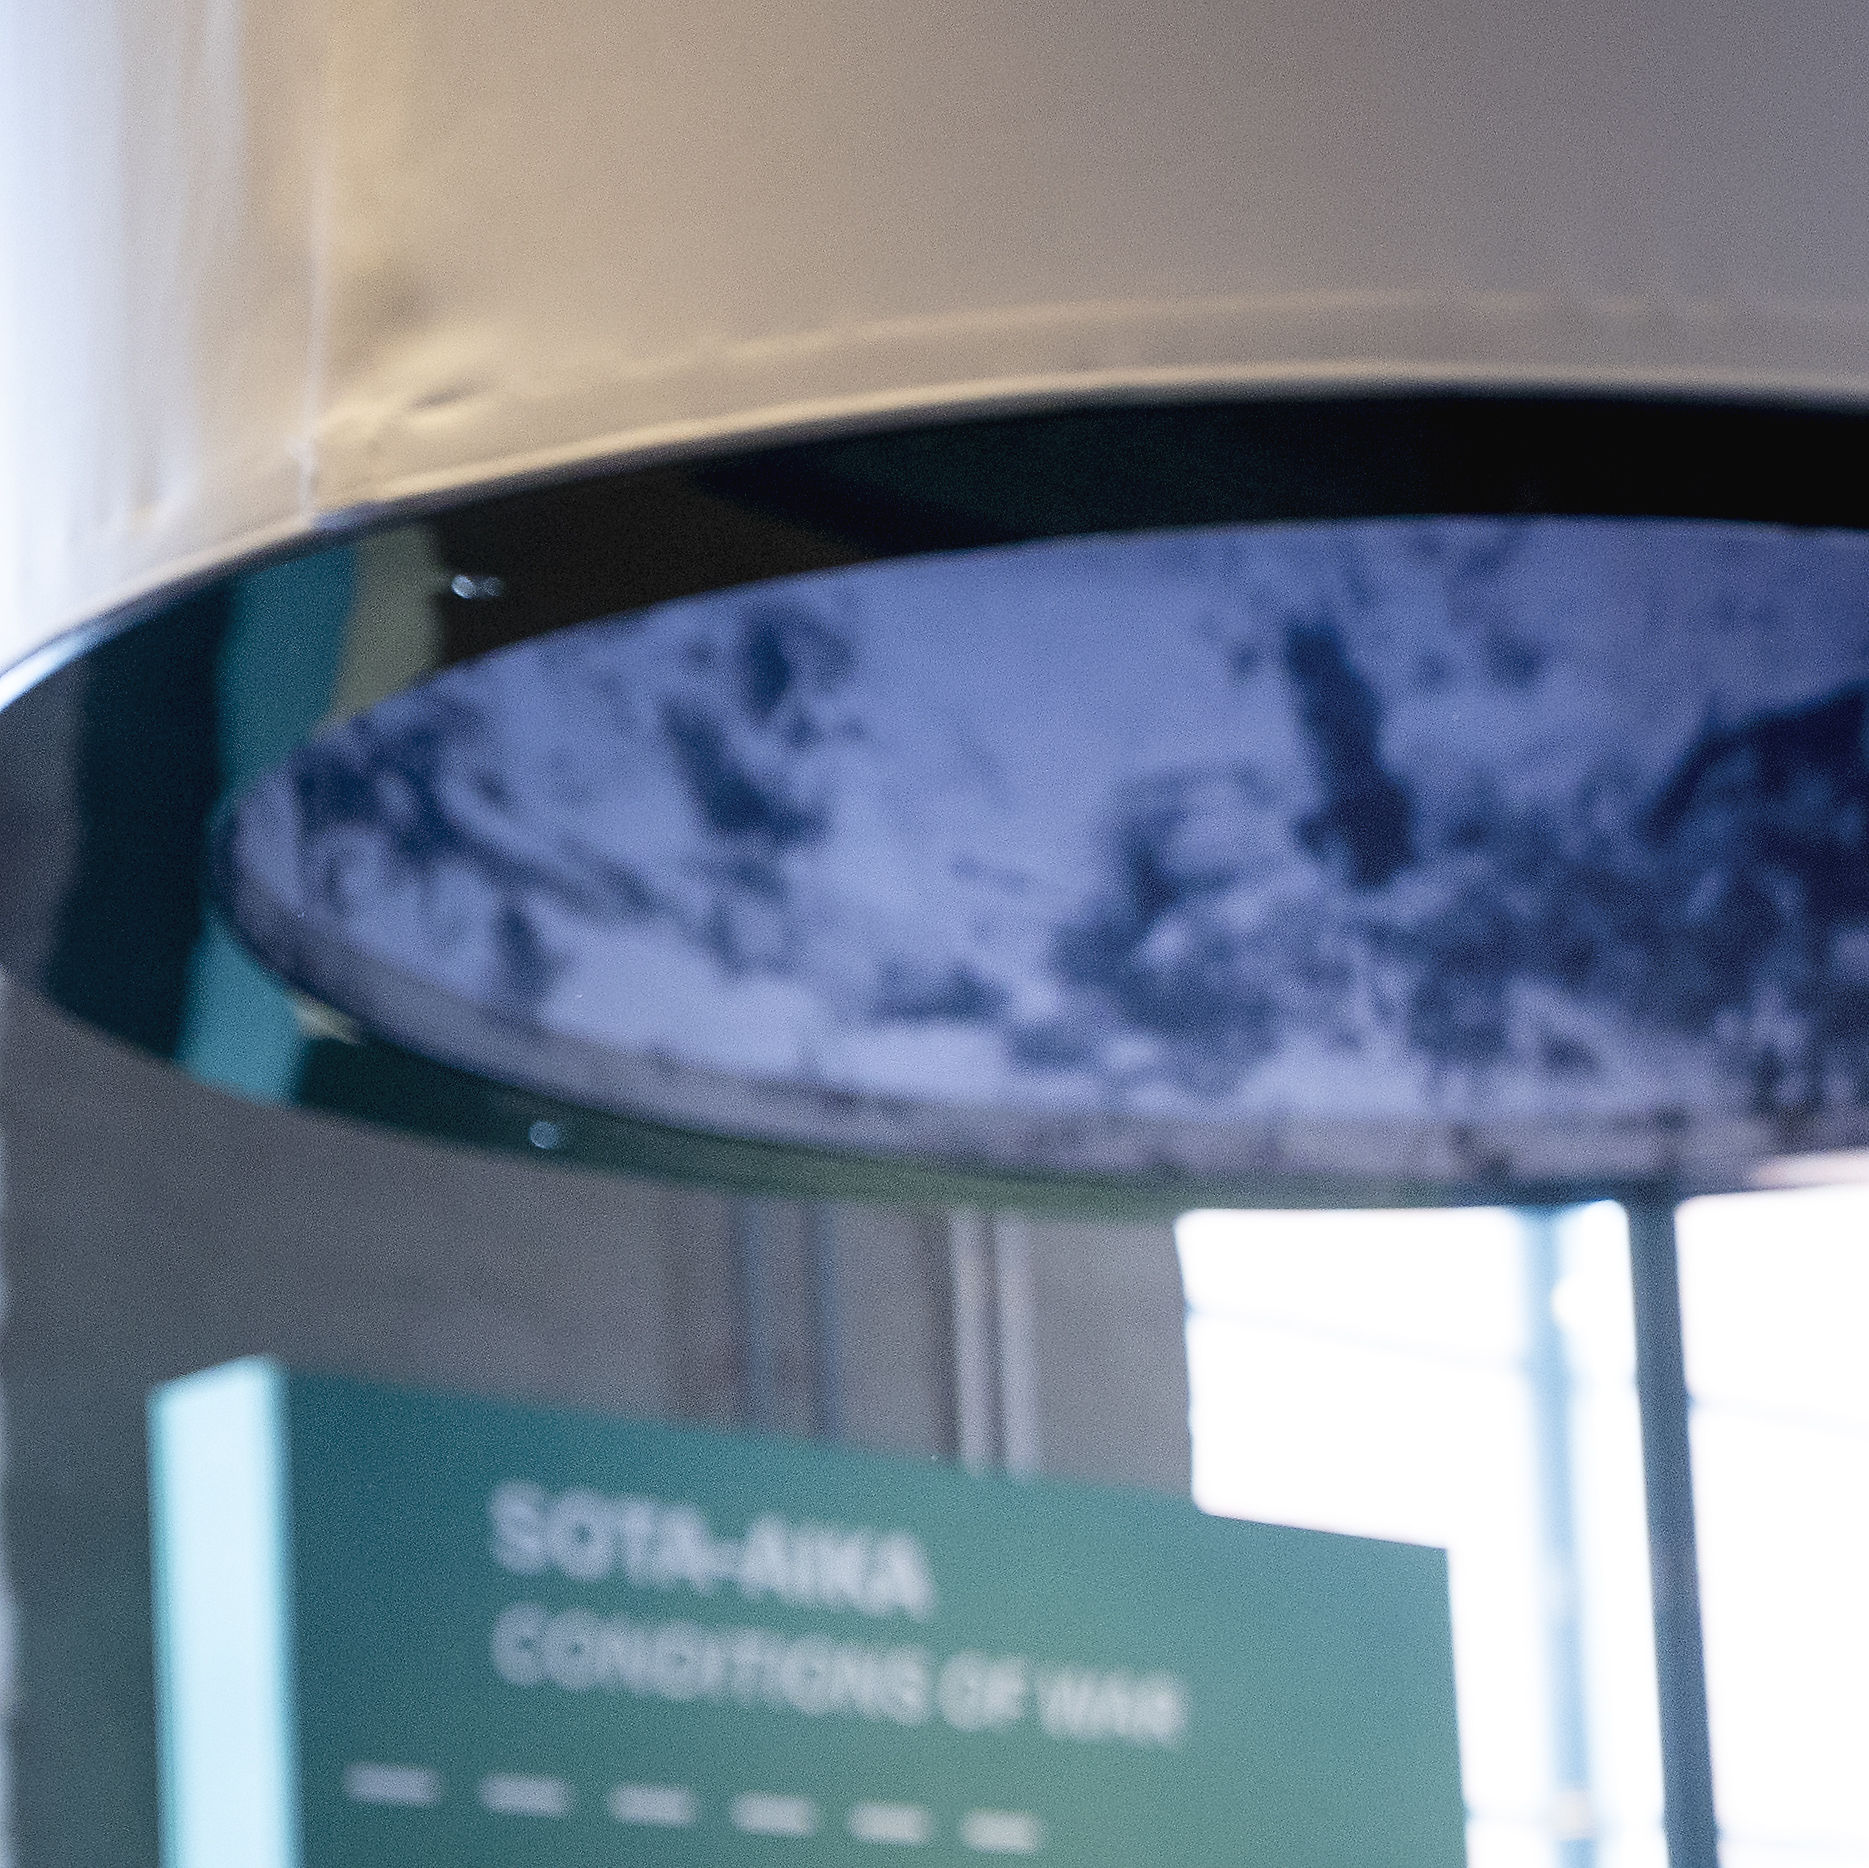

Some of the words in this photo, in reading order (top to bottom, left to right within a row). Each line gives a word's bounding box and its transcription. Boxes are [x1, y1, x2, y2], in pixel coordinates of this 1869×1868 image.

[488, 1479, 938, 1622] SOTA-AIKA
[490, 1602, 933, 1727] CONDITIONS
[938, 1650, 1030, 1734] OF
[1034, 1662, 1188, 1748] WAR
